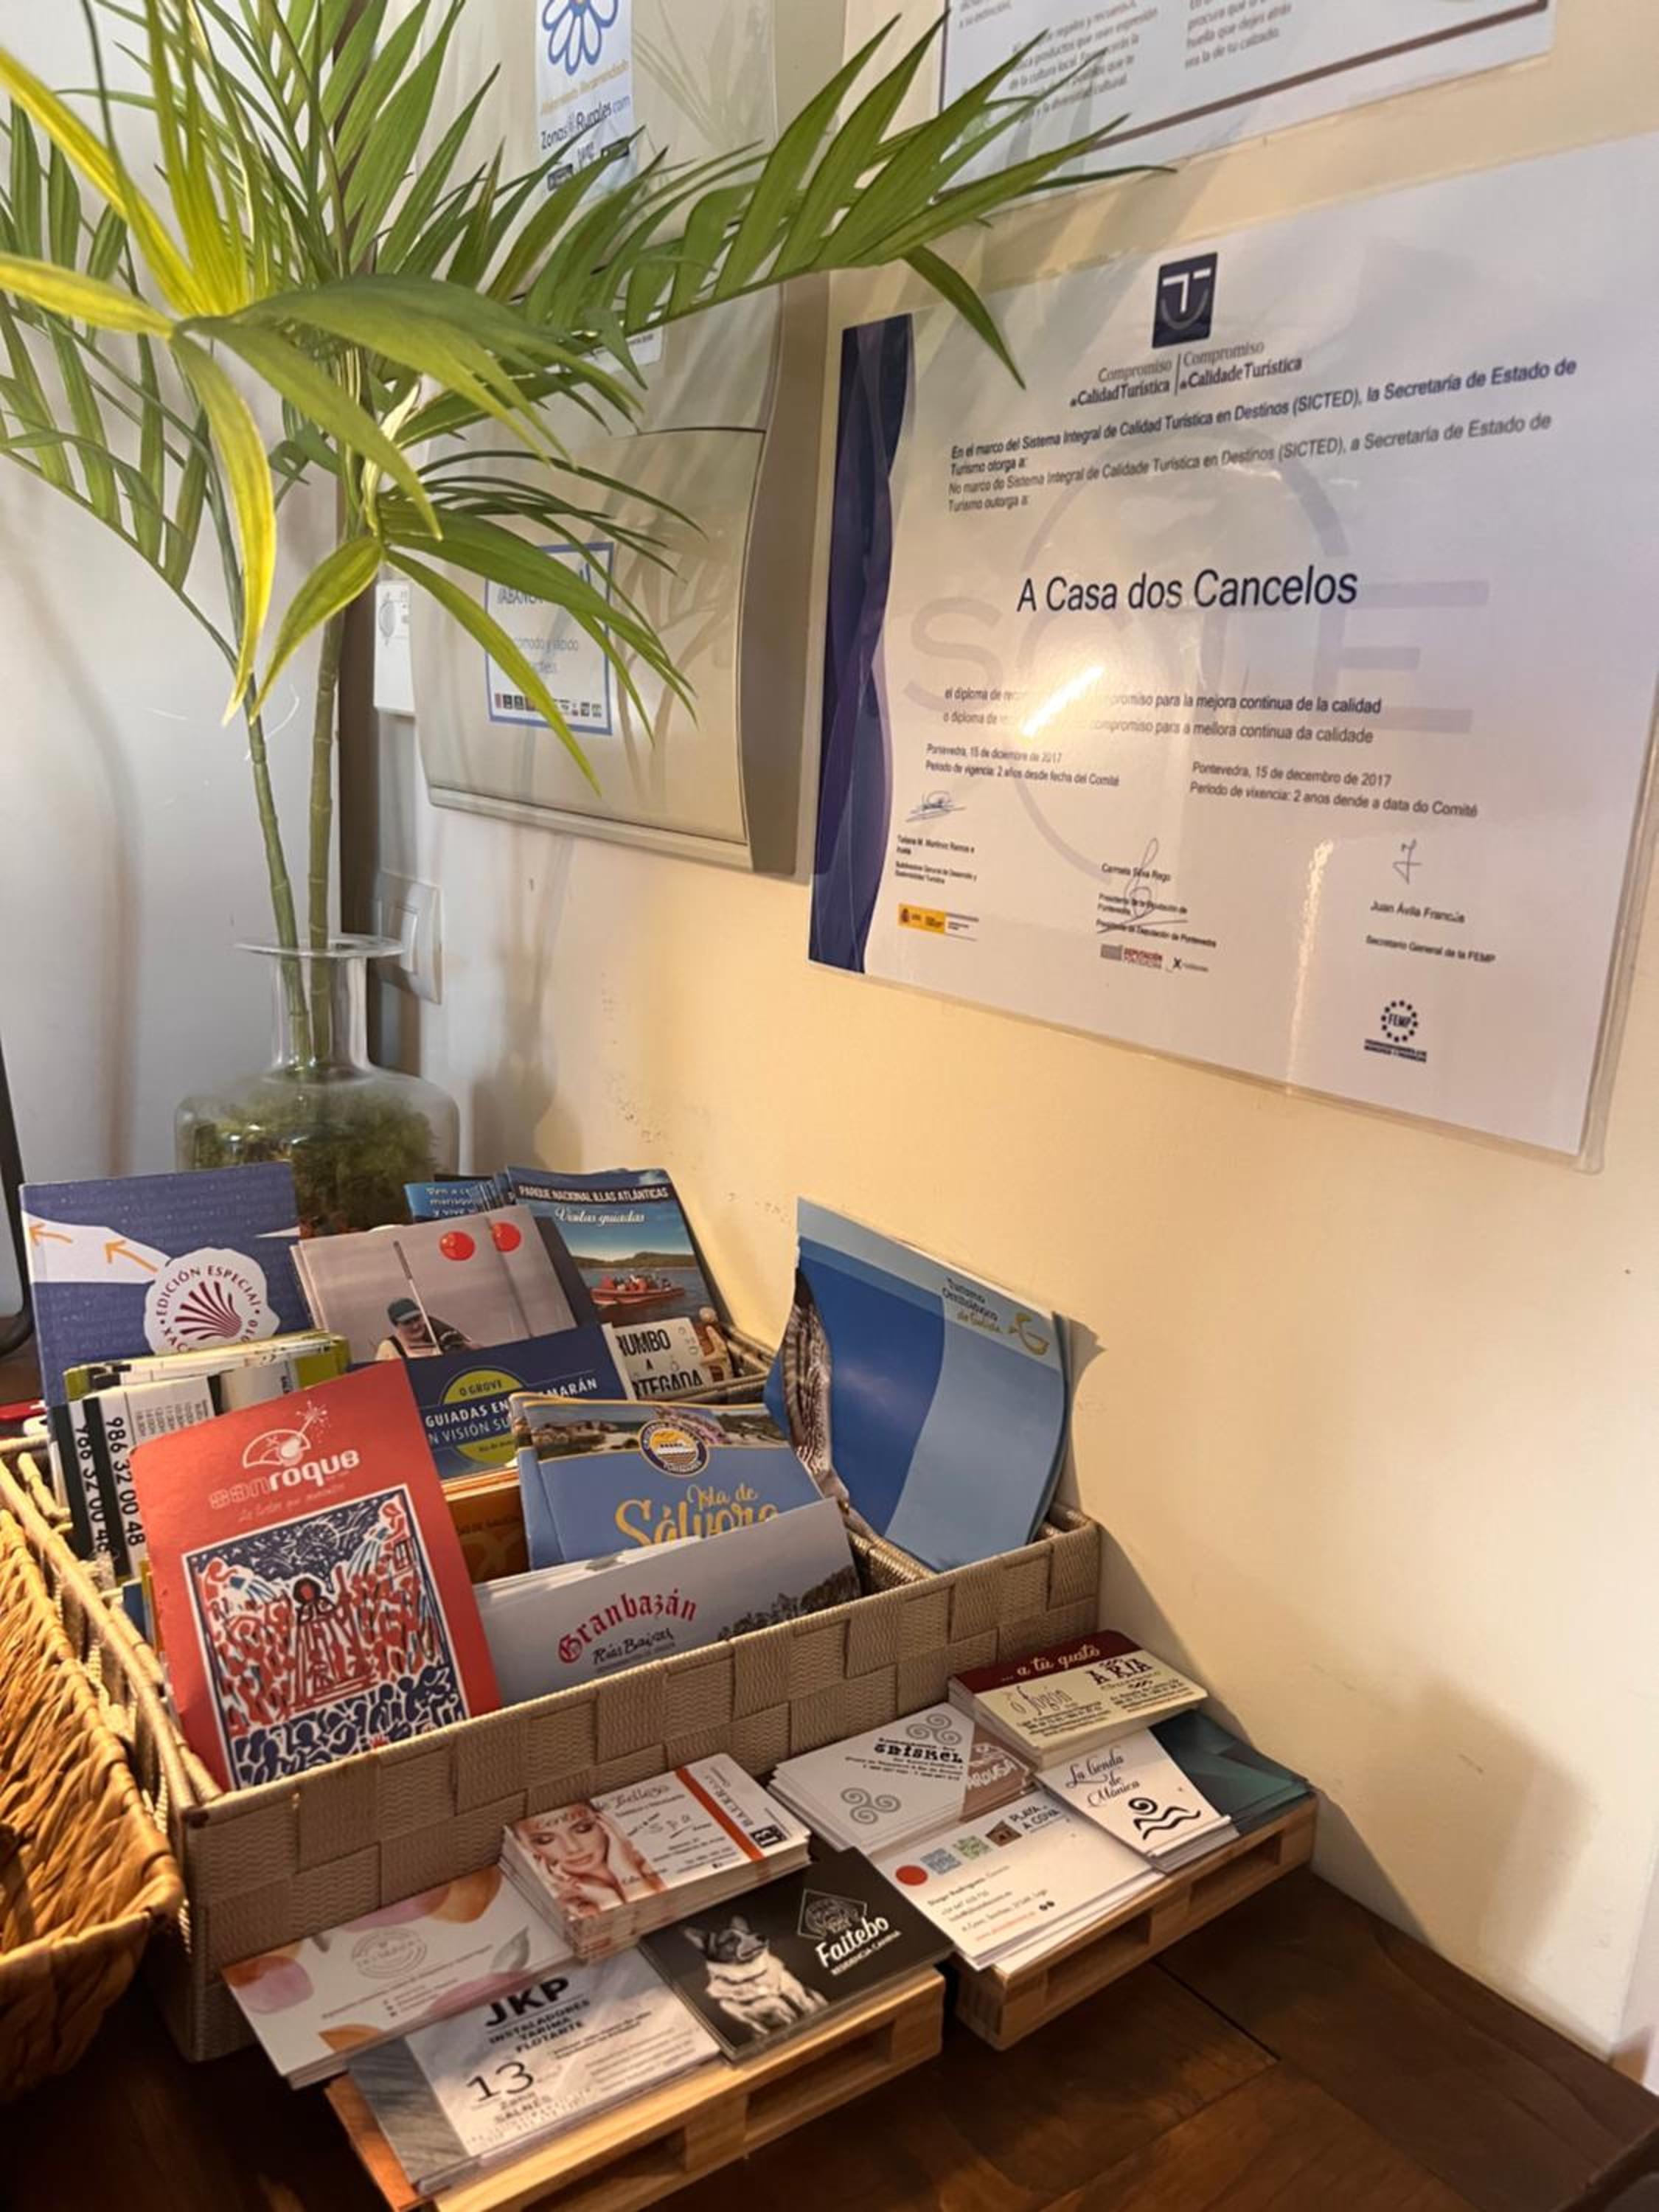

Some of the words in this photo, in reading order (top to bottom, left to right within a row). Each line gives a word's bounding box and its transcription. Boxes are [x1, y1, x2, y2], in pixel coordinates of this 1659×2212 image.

[1183, 341, 1265, 367] Compromiso
[1097, 358, 1172, 382] Compromiso
[1245, 357, 1302, 378] Turística
[951, 445, 964, 459] En
[966, 443, 974, 456] el
[975, 442, 1004, 456] marco
[1005, 437, 1020, 451] del
[1022, 434, 1060, 450] Sistema
[1063, 425, 1102, 445] Integral
[1104, 424, 1117, 438] de
[1119, 418, 1162, 437] Calidad
[1165, 411, 1213, 430] Turística
[1216, 411, 1231, 424] en
[1234, 401, 1290, 420] Destinos
[1292, 389, 1362, 417] (SICTED),
[1367, 386, 1380, 402] la
[1383, 374, 1461, 400] Secretaría
[1465, 371, 1485, 389] de
[1490, 362, 1551, 386] Estado
[1554, 357, 1576, 376] de
[948, 482, 961, 495] No
[963, 480, 991, 493] marco
[992, 479, 1005, 490] do
[1007, 474, 1045, 490] Sistema
[1046, 467, 1085, 486] Integral
[1086, 466, 1099, 479] de
[1102, 459, 1150, 479] Calidade
[1203, 455, 1217, 467] en
[1221, 446, 1275, 466] Destinos
[1279, 437, 1346, 462] (SICTED),
[1350, 438, 1360, 451] a
[1364, 425, 1439, 450] Secretaría
[1443, 424, 1463, 439] de
[1468, 415, 1525, 437] Estado
[1528, 411, 1552, 431] de
[950, 462, 985, 476] Turismo
[987, 458, 1016, 473] otorga
[948, 498, 983, 512] Turismo
[984, 495, 1018, 509] outorga
[1017, 578, 1037, 612] A
[1046, 576, 1117, 612] Casa
[1128, 572, 1183, 608] dos
[1193, 565, 1358, 608] Cancelos
[945, 689, 952, 700] el
[954, 687, 988, 702] diploma
[990, 689, 1001, 700] de
[1155, 695, 1180, 708] para
[1183, 694, 1194, 706] la
[1196, 695, 1237, 710] mejora
[1239, 695, 1293, 712] continua
[1296, 695, 1313, 712] de
[1316, 696, 1328, 712] la
[1331, 697, 1382, 715] calidad
[951, 712, 984, 725] diploma
[1155, 722, 1180, 735] para
[1183, 723, 1190, 734] a
[1193, 722, 1237, 737] mellora
[1239, 724, 1293, 740] continua
[1296, 725, 1312, 740] da
[1315, 726, 1374, 744] calidade
[1025, 769, 1048, 780] desde
[1050, 771, 1072, 782] fecha
[1074, 773, 1087, 784] del
[1192, 761, 1251, 779] Pontevedra,
[1256, 765, 1268, 778] 15
[1270, 768, 1283, 779] de
[1286, 769, 1341, 783] decembro
[1343, 772, 1358, 785] de
[1360, 773, 1392, 787] 2017
[1230, 785, 1243, 798] de
[1293, 790, 1302, 802] 2
[1303, 793, 1330, 804] anos
[1332, 793, 1369, 809] dende
[1382, 797, 1410, 812] data
[1413, 800, 1429, 814] do
[1432, 800, 1478, 818] Comité
[1370, 901, 1394, 913] Juan
[1366, 935, 1408, 950] Secretario
[1409, 942, 1443, 956] General
[1388, 1013, 1412, 1028] FEMP
[518, 1185, 552, 1199] PARQUE
[552, 1189, 592, 1202] NACIONAL
[593, 1192, 616, 1202] ILLAS
[618, 1187, 668, 1202] ATLÁNTICAS
[156, 1267, 201, 1316] EDICIÓN
[207, 1265, 262, 1307] ESPECIAL
[646, 1359, 654, 1369] A
[459, 1388, 466, 1397] O
[468, 1380, 502, 1395] GROVE
[425, 1404, 488, 1428] GUIADAS
[105, 1416, 128, 1453] 986
[442, 1422, 490, 1442] VISIÓN
[119, 1489, 139, 1515] 00
[125, 1522, 145, 1545] 48
[558, 1588, 696, 1663] Granbazán
[592, 1644, 622, 1664] Rías
[1058, 1644, 1100, 1669] gusto
[1087, 1745, 1124, 1775] tienda
[1108, 1772, 1122, 1787] de
[1087, 1780, 1141, 1806] Mónica
[815, 1917, 889, 1968] Faitebo
[486, 1978, 569, 2026] JKP
[490, 1999, 590, 2043] INSTALADORES
[519, 2017, 571, 2040] TARIMA
[516, 2021, 583, 2053] FLOTANTE
[467, 2062, 534, 2101] 13
